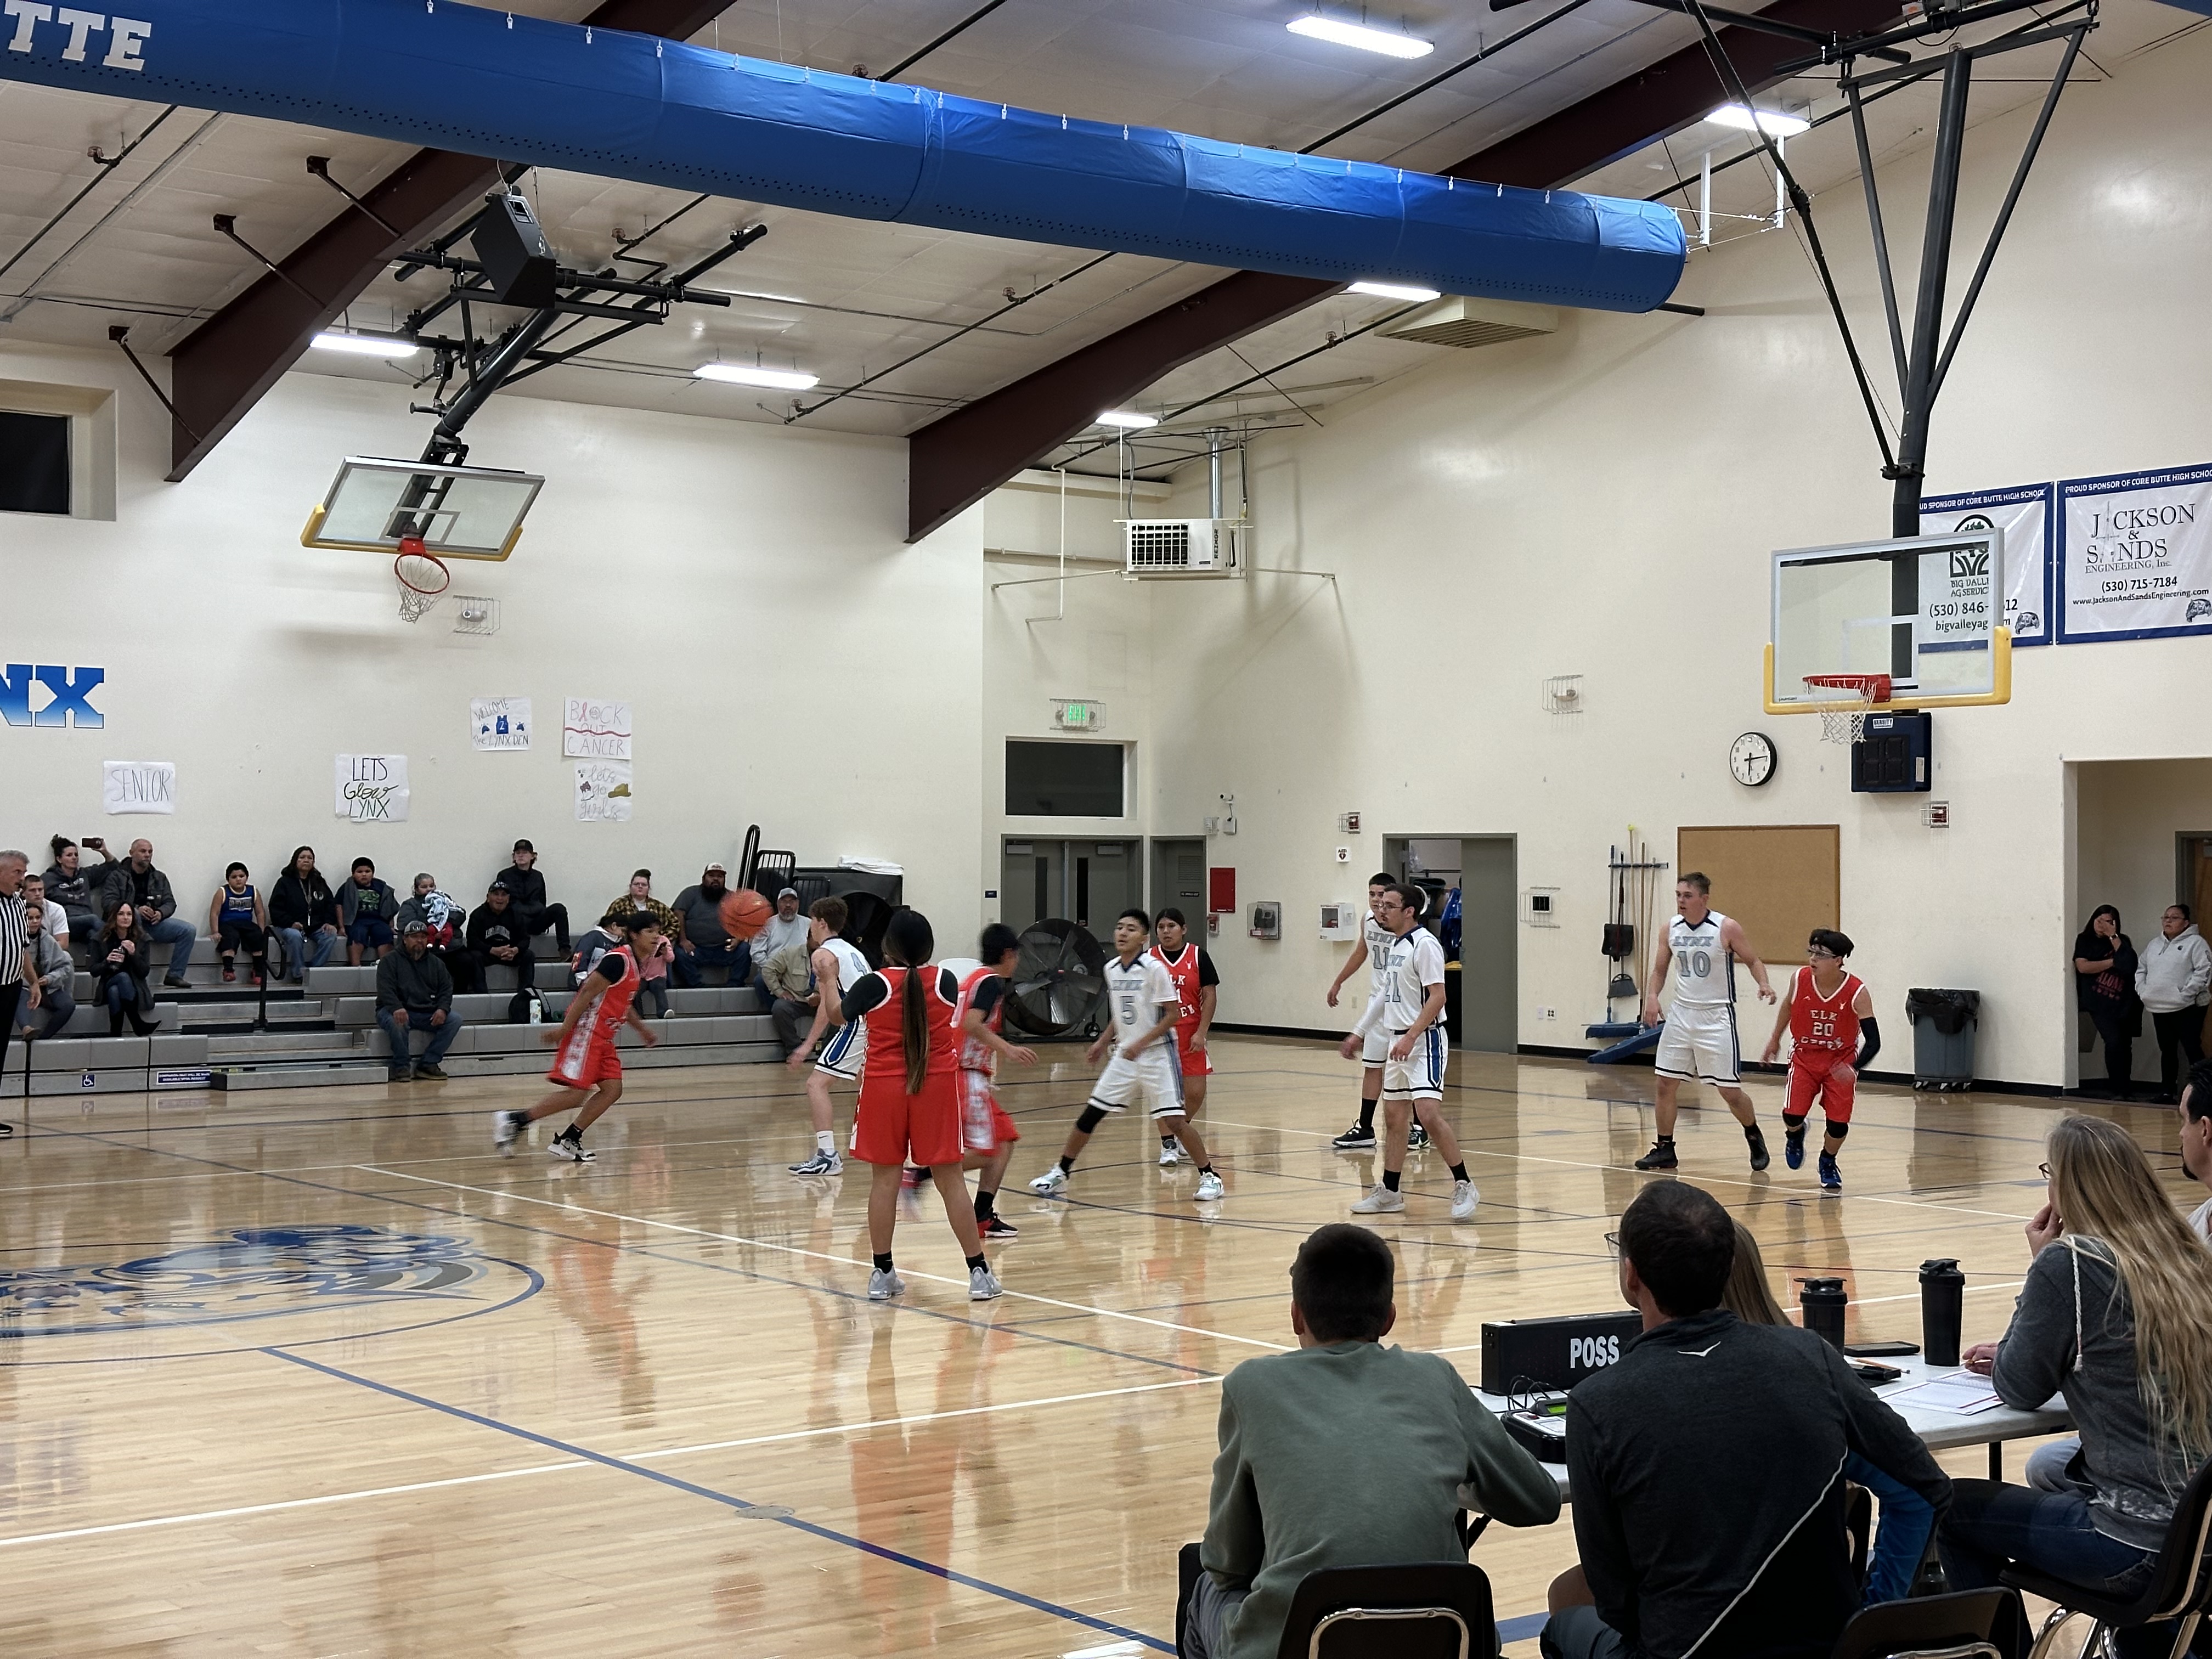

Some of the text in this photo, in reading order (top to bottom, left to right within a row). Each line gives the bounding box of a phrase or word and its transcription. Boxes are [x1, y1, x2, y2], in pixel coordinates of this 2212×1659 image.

[4, 0, 151, 71] TTE
[2065, 483, 2087, 493] PROUD
[2088, 481, 2120, 491] SPONSOR
[2121, 479, 2131, 487] OF
[2131, 477, 2149, 486] CORE
[2151, 474, 2171, 484] BUTTE
[2172, 472, 2190, 482] HIGH
[1928, 499, 1956, 509] SPONSOR
[1957, 498, 1966, 506] OF
[1966, 496, 1982, 505] CORE
[1983, 494, 2003, 504] BUTTE
[2003, 492, 2020, 501] HIGH
[2020, 489, 2045, 499] SCHOOL
[2128, 530, 2140, 540] &
[2085, 560, 2154, 574] ENGINEERING,
[1950, 579, 1963, 588] BIG
[1951, 588, 1962, 597] AG
[2101, 576, 2177, 594] (530) 715-7184
[2073, 589, 2209, 605] www.JacksonAndSandsEngineering.com
[1929, 602, 1958, 618] (530)
[474, 698, 510, 721] WELCOME
[473, 735, 528, 748] The LYNX DEN
[567, 736, 625, 755] CANCER
[352, 757, 388, 782] LETS
[110, 768, 172, 803] SENIOR
[343, 782, 399, 800] Glow
[349, 798, 391, 819] LYNX
[1366, 930, 1396, 944] LYNX
[1672, 935, 1714, 947] LYNX
[1677, 951, 1711, 978] 10
[1120, 996, 1138, 1025] 5
[1810, 1009, 1838, 1021] ELK
[1813, 1022, 1835, 1037] 20
[1570, 1335, 1619, 1369] POSS
